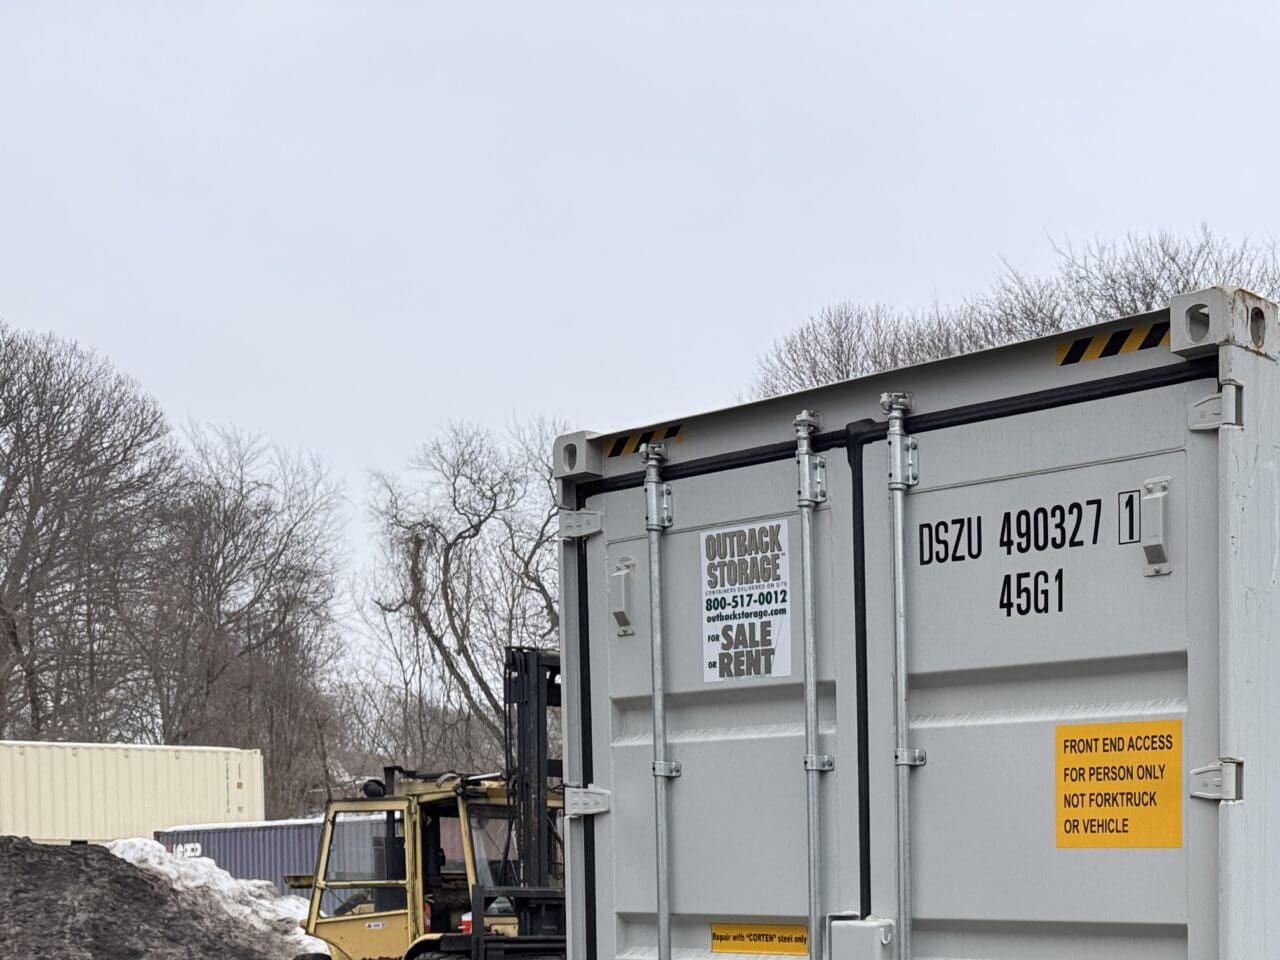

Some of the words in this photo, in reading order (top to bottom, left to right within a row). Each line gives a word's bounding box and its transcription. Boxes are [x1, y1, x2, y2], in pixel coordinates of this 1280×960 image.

[705, 524, 783, 562] OUTBACK
[919, 515, 982, 566] DSZU
[999, 498, 1102, 556] 490327
[707, 553, 781, 590] STORAGE
[706, 589, 787, 611] 800-517-0012
[999, 568, 1063, 617] 45G1
[707, 608, 787, 623] outbackstorage.com
[708, 634, 720, 643] FOR
[721, 621, 772, 651] SALE
[708, 661, 717, 669] OR
[719, 648, 775, 678] RENT
[1063, 738, 1099, 754] FRONT
[1102, 737, 1125, 753] END
[1127, 734, 1173, 752] ACCESS
[1063, 767, 1086, 782] FOR
[1089, 765, 1134, 782] PERSON
[1137, 764, 1166, 780] ONLY
[1063, 793, 1086, 808] NOT
[1089, 791, 1157, 808] FORKTRUCK
[1063, 819, 1080, 834] OR
[1082, 818, 1129, 834] VEHICLE
[712, 932, 731, 943] Repair
[732, 932, 745, 941] with
[778, 934, 793, 944] steel
[794, 934, 807, 946] only
